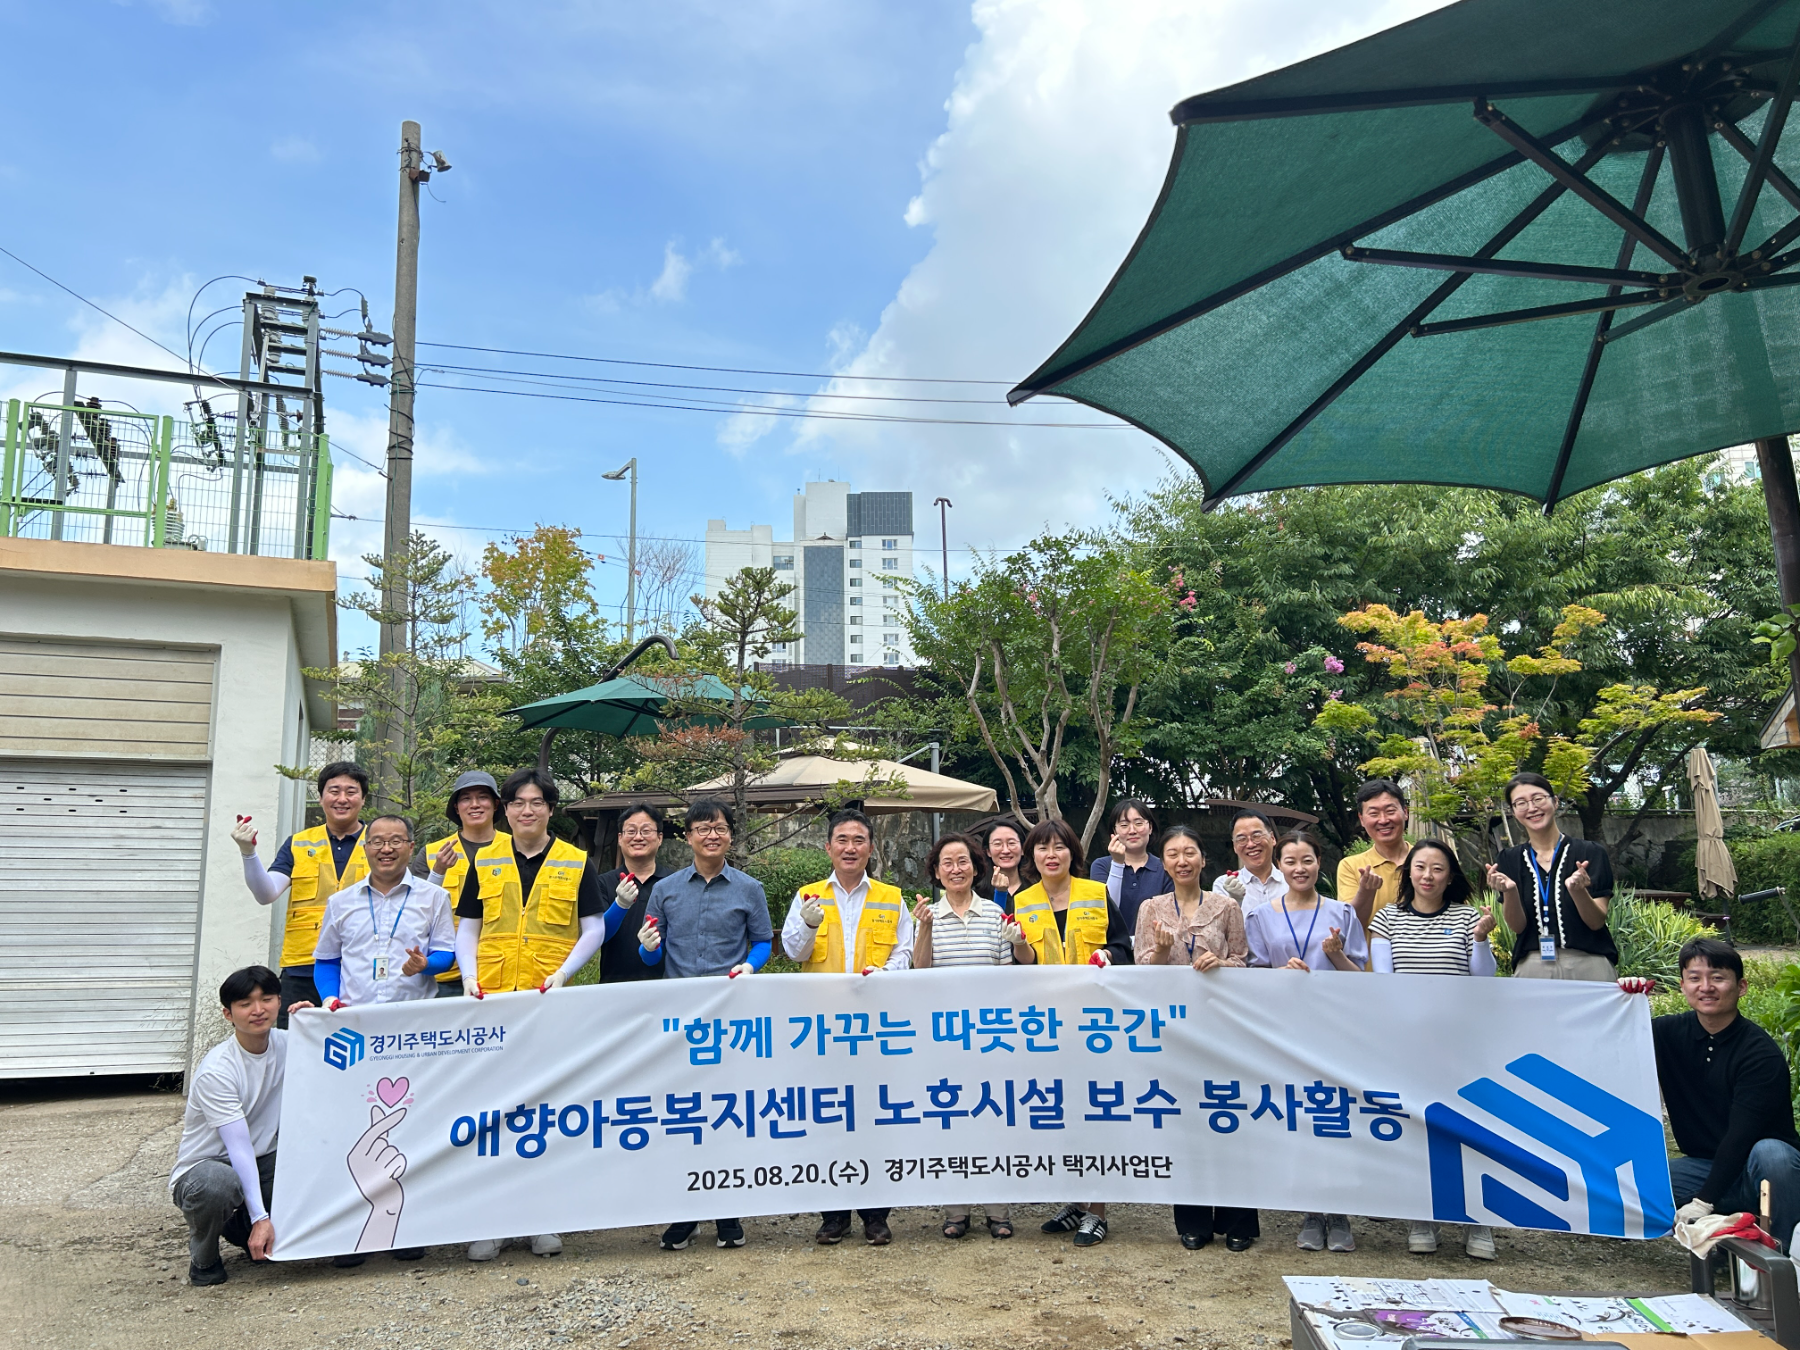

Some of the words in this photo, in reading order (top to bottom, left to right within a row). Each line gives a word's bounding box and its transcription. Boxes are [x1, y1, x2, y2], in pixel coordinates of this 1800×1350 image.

[370, 1025, 506, 1054] 경기주택도시공사
[438, 1048, 470, 1056] DEVELOPMENT
[471, 1045, 504, 1053] CORPORATION
[662, 1015, 773, 1066] "함께
[788, 1011, 917, 1056] 가꾸는
[931, 1004, 1063, 1054] 따뜻한
[1077, 1004, 1187, 1054] 공간"
[449, 1085, 856, 1159] 애향아동복지센터
[874, 1077, 1066, 1131] 노후시설
[1084, 1079, 1182, 1129] 보수
[1198, 1079, 1411, 1142] 봉사활동
[687, 1158, 869, 1192] 2025.08.20.(수)
[884, 1154, 1056, 1182] 경기주택도시공사
[1062, 1154, 1173, 1179] 택지사업단
